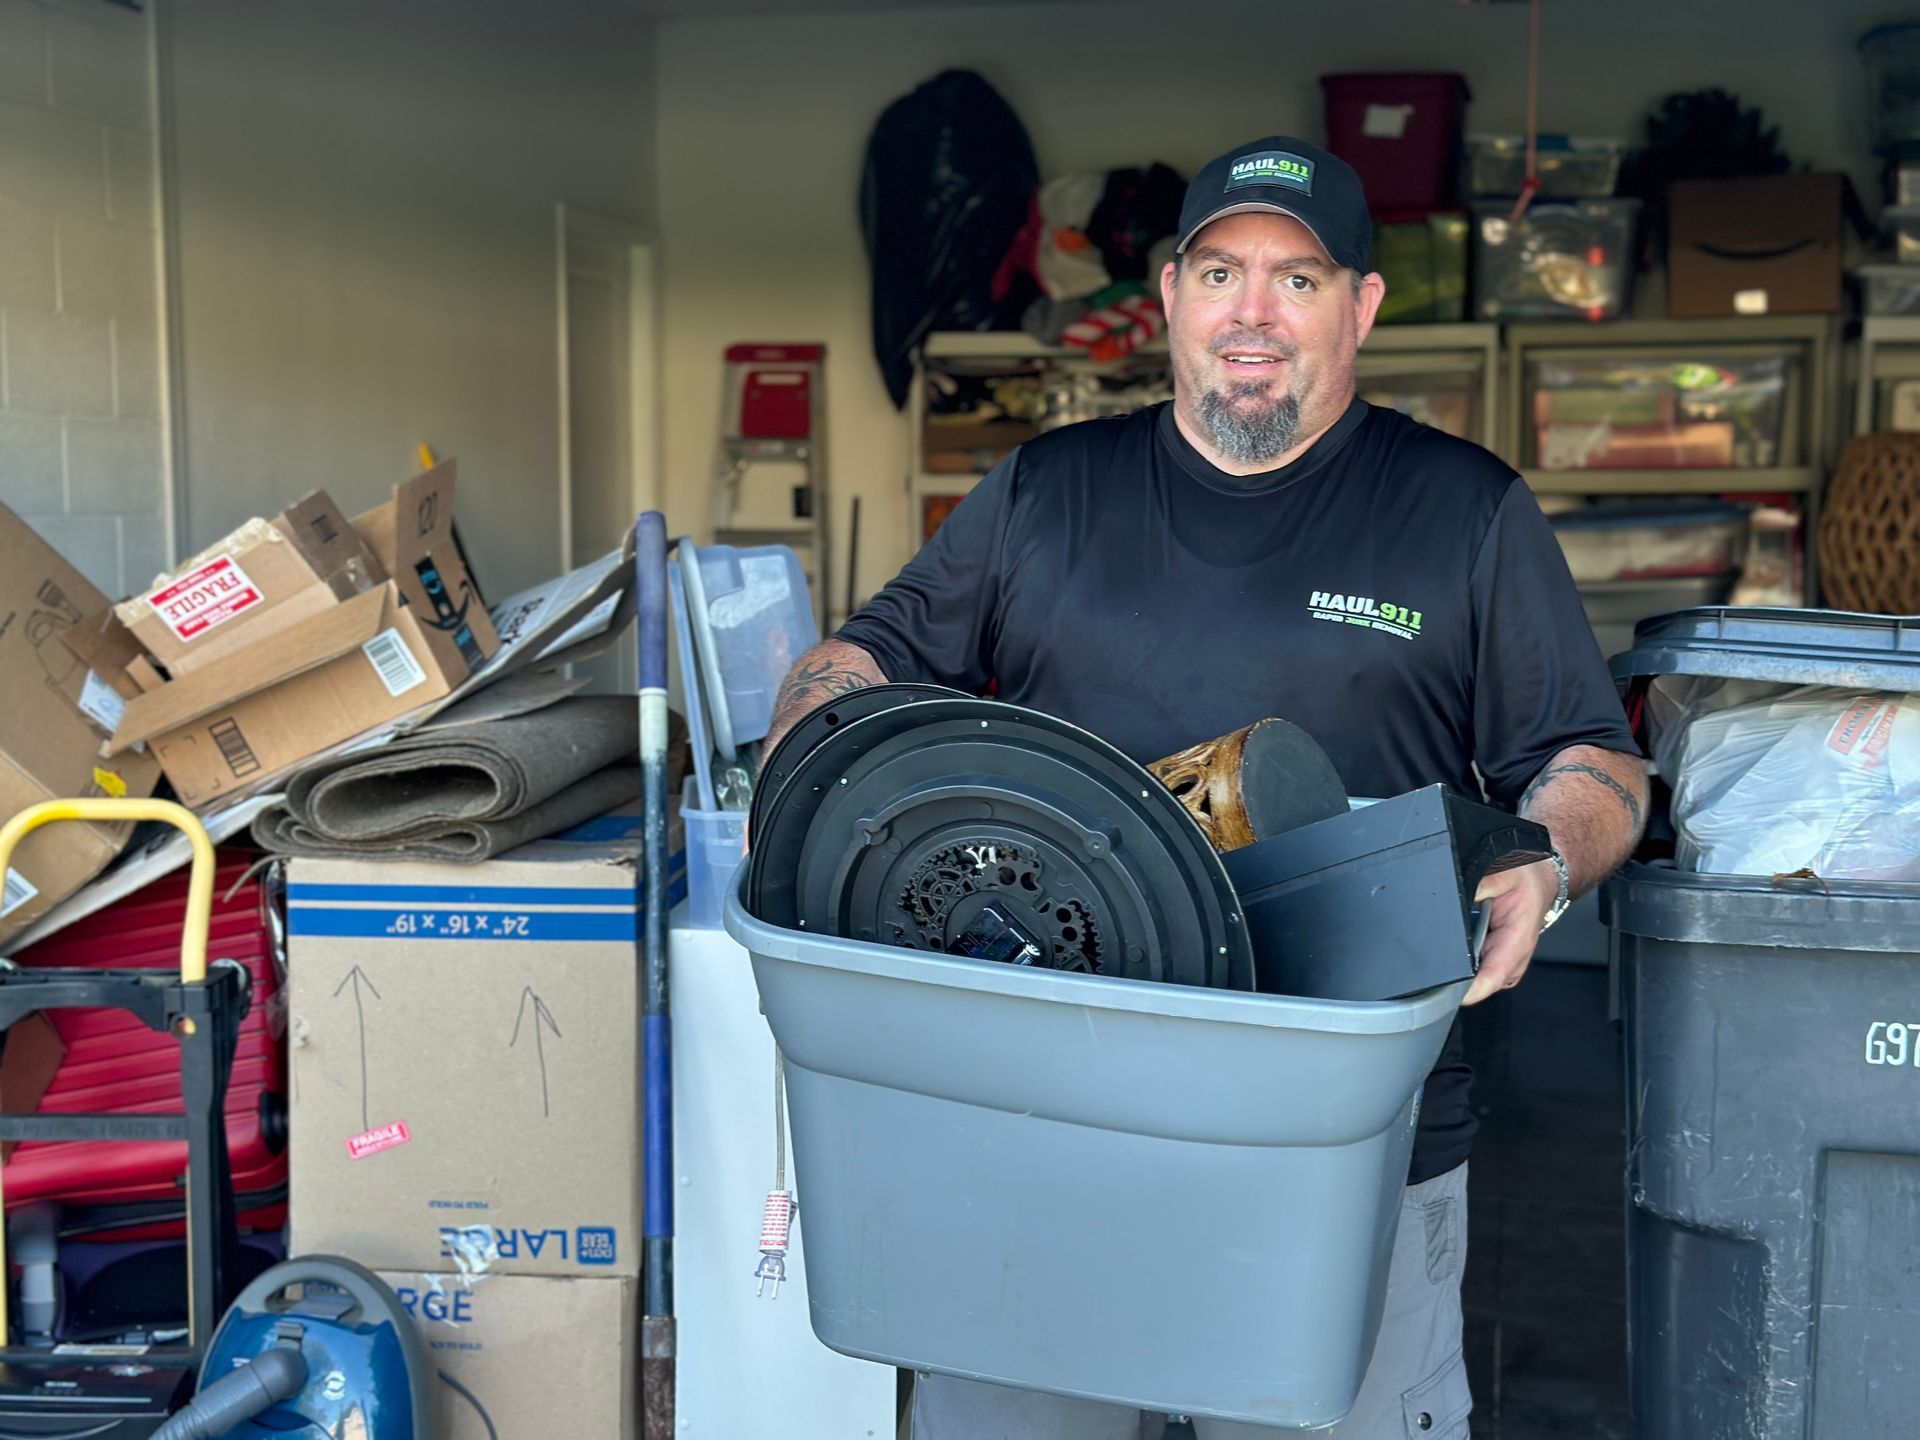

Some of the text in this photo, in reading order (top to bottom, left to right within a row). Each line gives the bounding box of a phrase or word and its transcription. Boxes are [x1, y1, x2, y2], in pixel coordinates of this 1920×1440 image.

[1232, 159, 1308, 177] HAUL911
[163, 571, 242, 620] FRAGILE
[1309, 591, 1422, 630] HAUL911
[352, 1123, 400, 1150] FRAGILE
[396, 1286, 474, 1322] RGE
